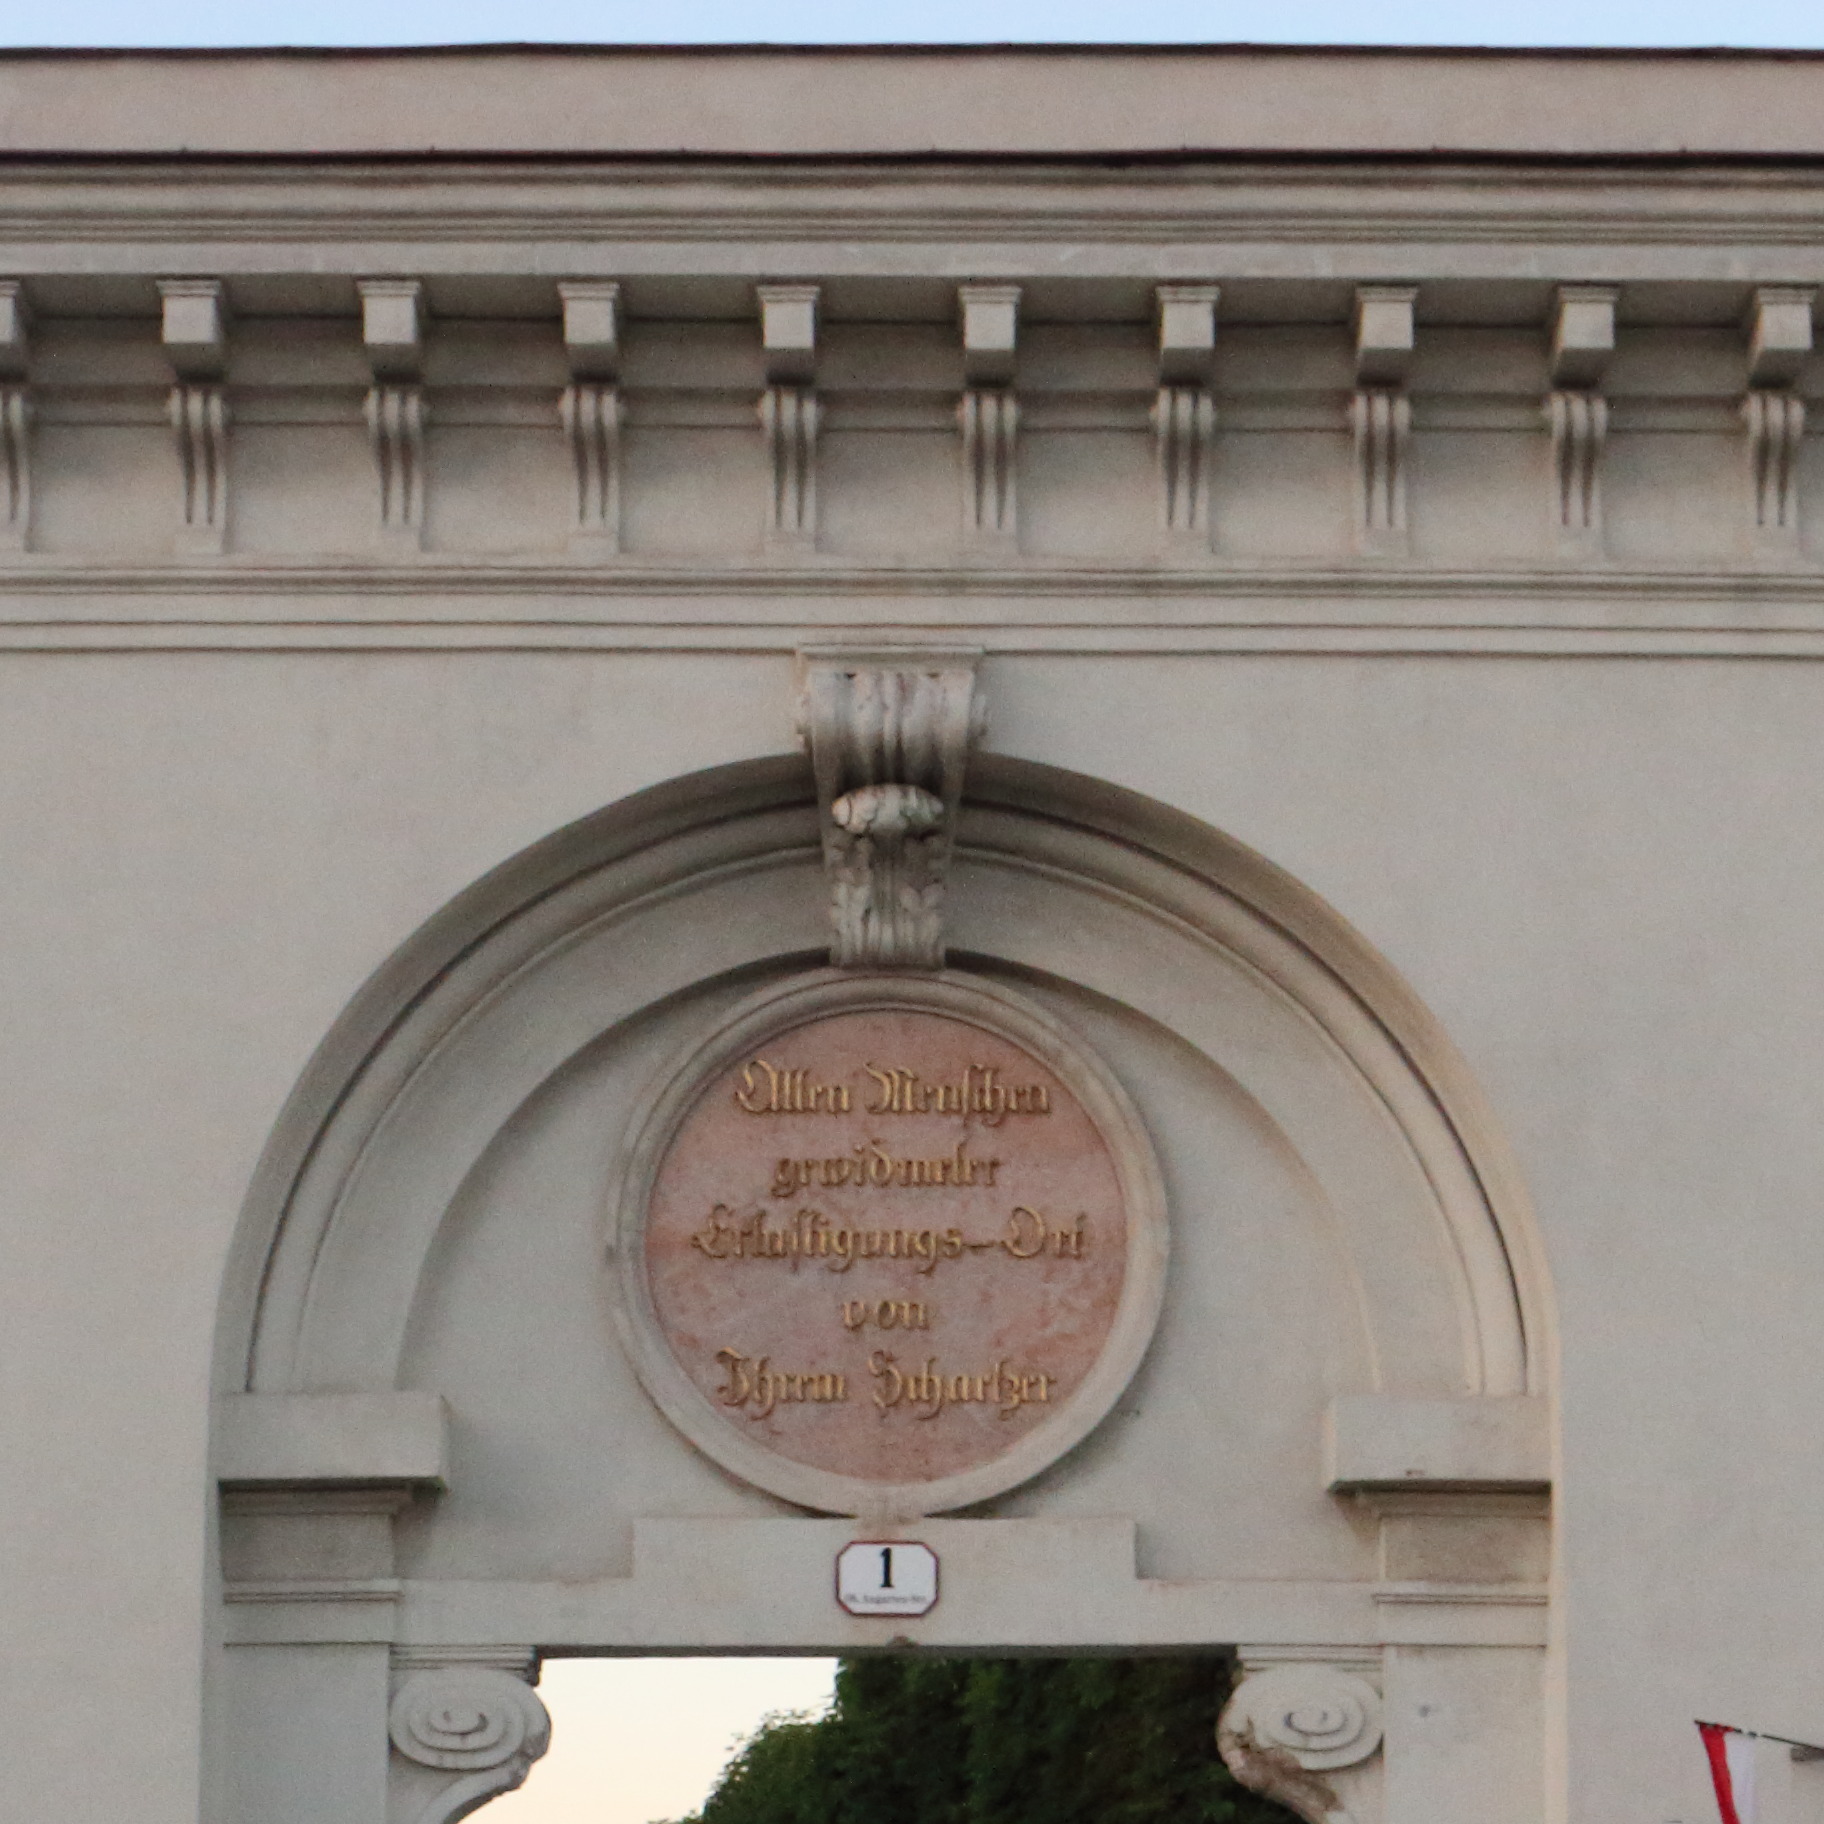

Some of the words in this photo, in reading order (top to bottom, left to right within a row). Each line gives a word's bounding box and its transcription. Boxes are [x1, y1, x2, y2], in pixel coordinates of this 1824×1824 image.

[736, 1060, 852, 1115] Allen
[864, 1061, 1052, 1128] Menschen
[771, 1137, 1002, 1198] gewidmeter
[842, 1299, 928, 1332] von
[879, 1547, 894, 1588] 1
